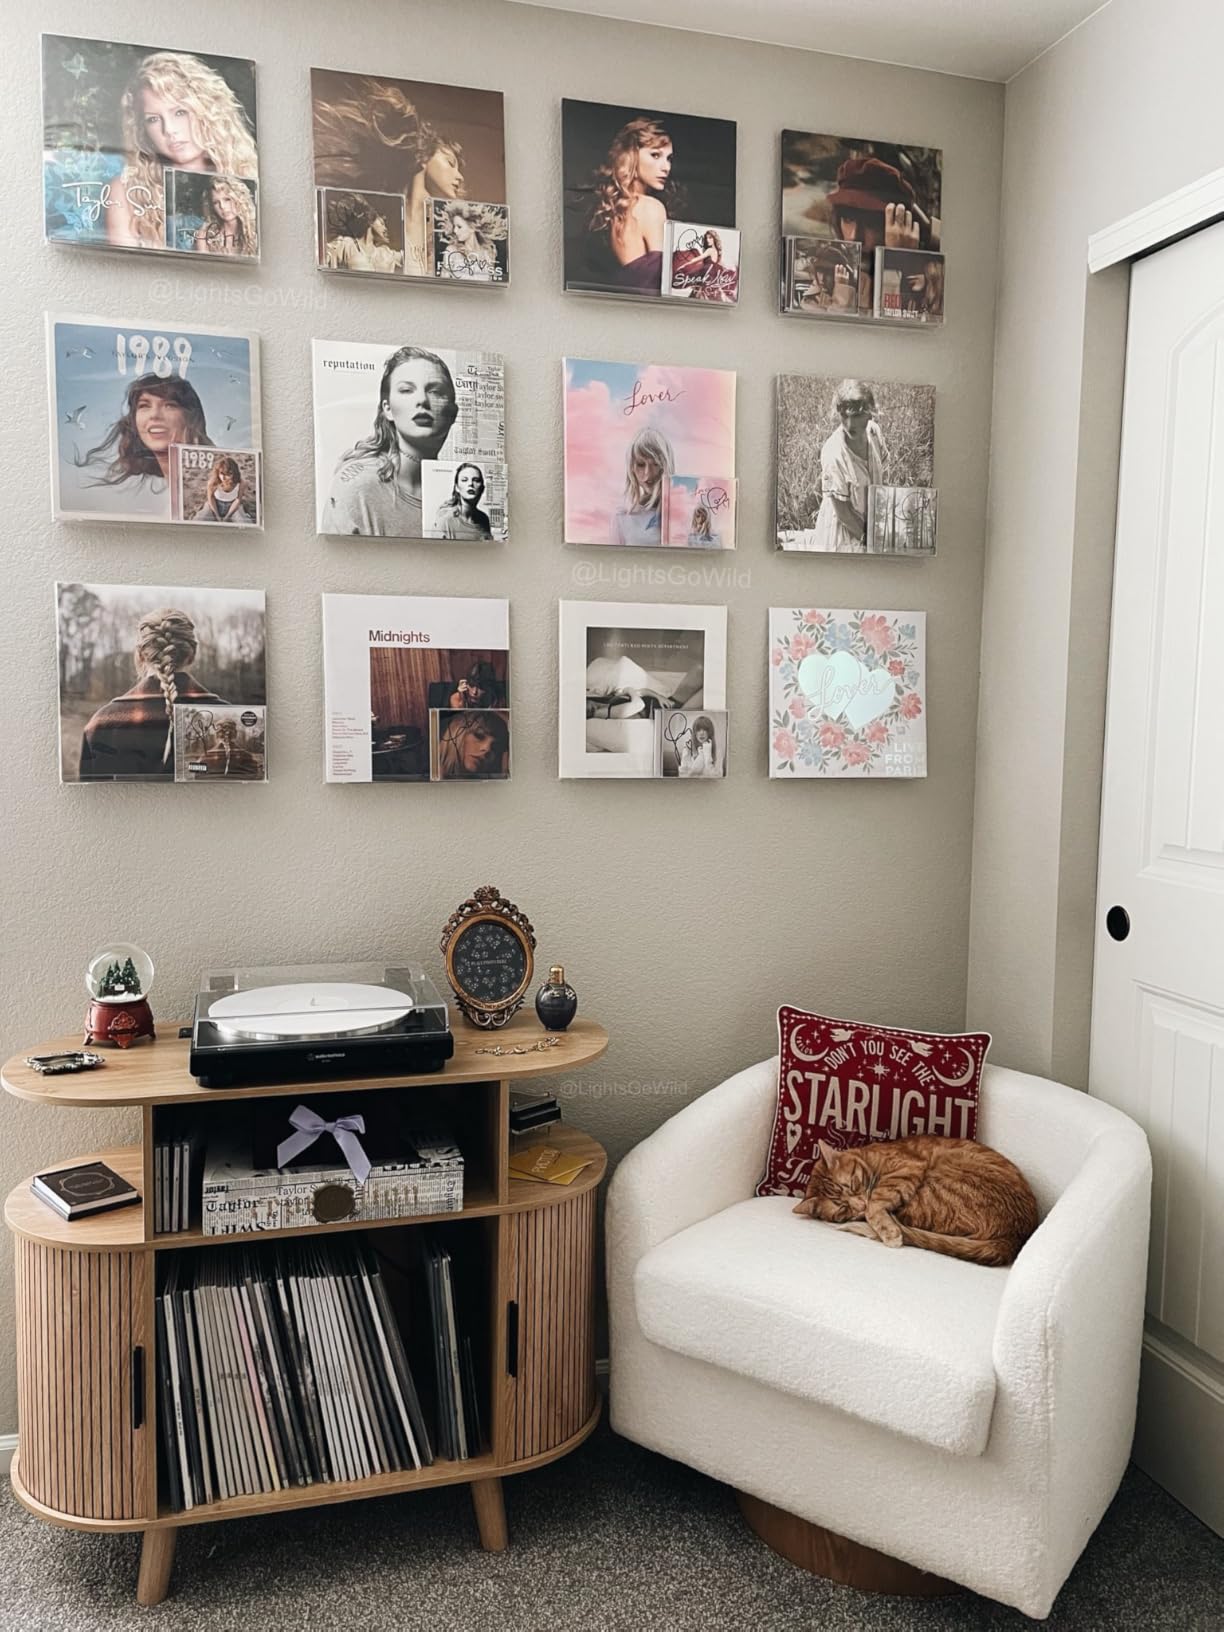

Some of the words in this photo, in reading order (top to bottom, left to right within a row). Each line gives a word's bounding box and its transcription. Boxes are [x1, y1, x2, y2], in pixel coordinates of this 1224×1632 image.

[62, 181, 122, 222] Taylor
[673, 264, 711, 289] Speak
[116, 333, 193, 380] 1989
[322, 359, 376, 371] reputation
[623, 380, 688, 416] Lover
[368, 629, 431, 645] Midnights
[808, 665, 894, 720] Lover
[824, 1042, 857, 1070] DON'T
[860, 1040, 885, 1056] YOU
[888, 1045, 913, 1067] SEE
[911, 1061, 937, 1087] THE
[783, 1069, 975, 1140] STARLIGHT
[206, 1196, 260, 1213] Taylor
[276, 1184, 307, 1196] Taylor
